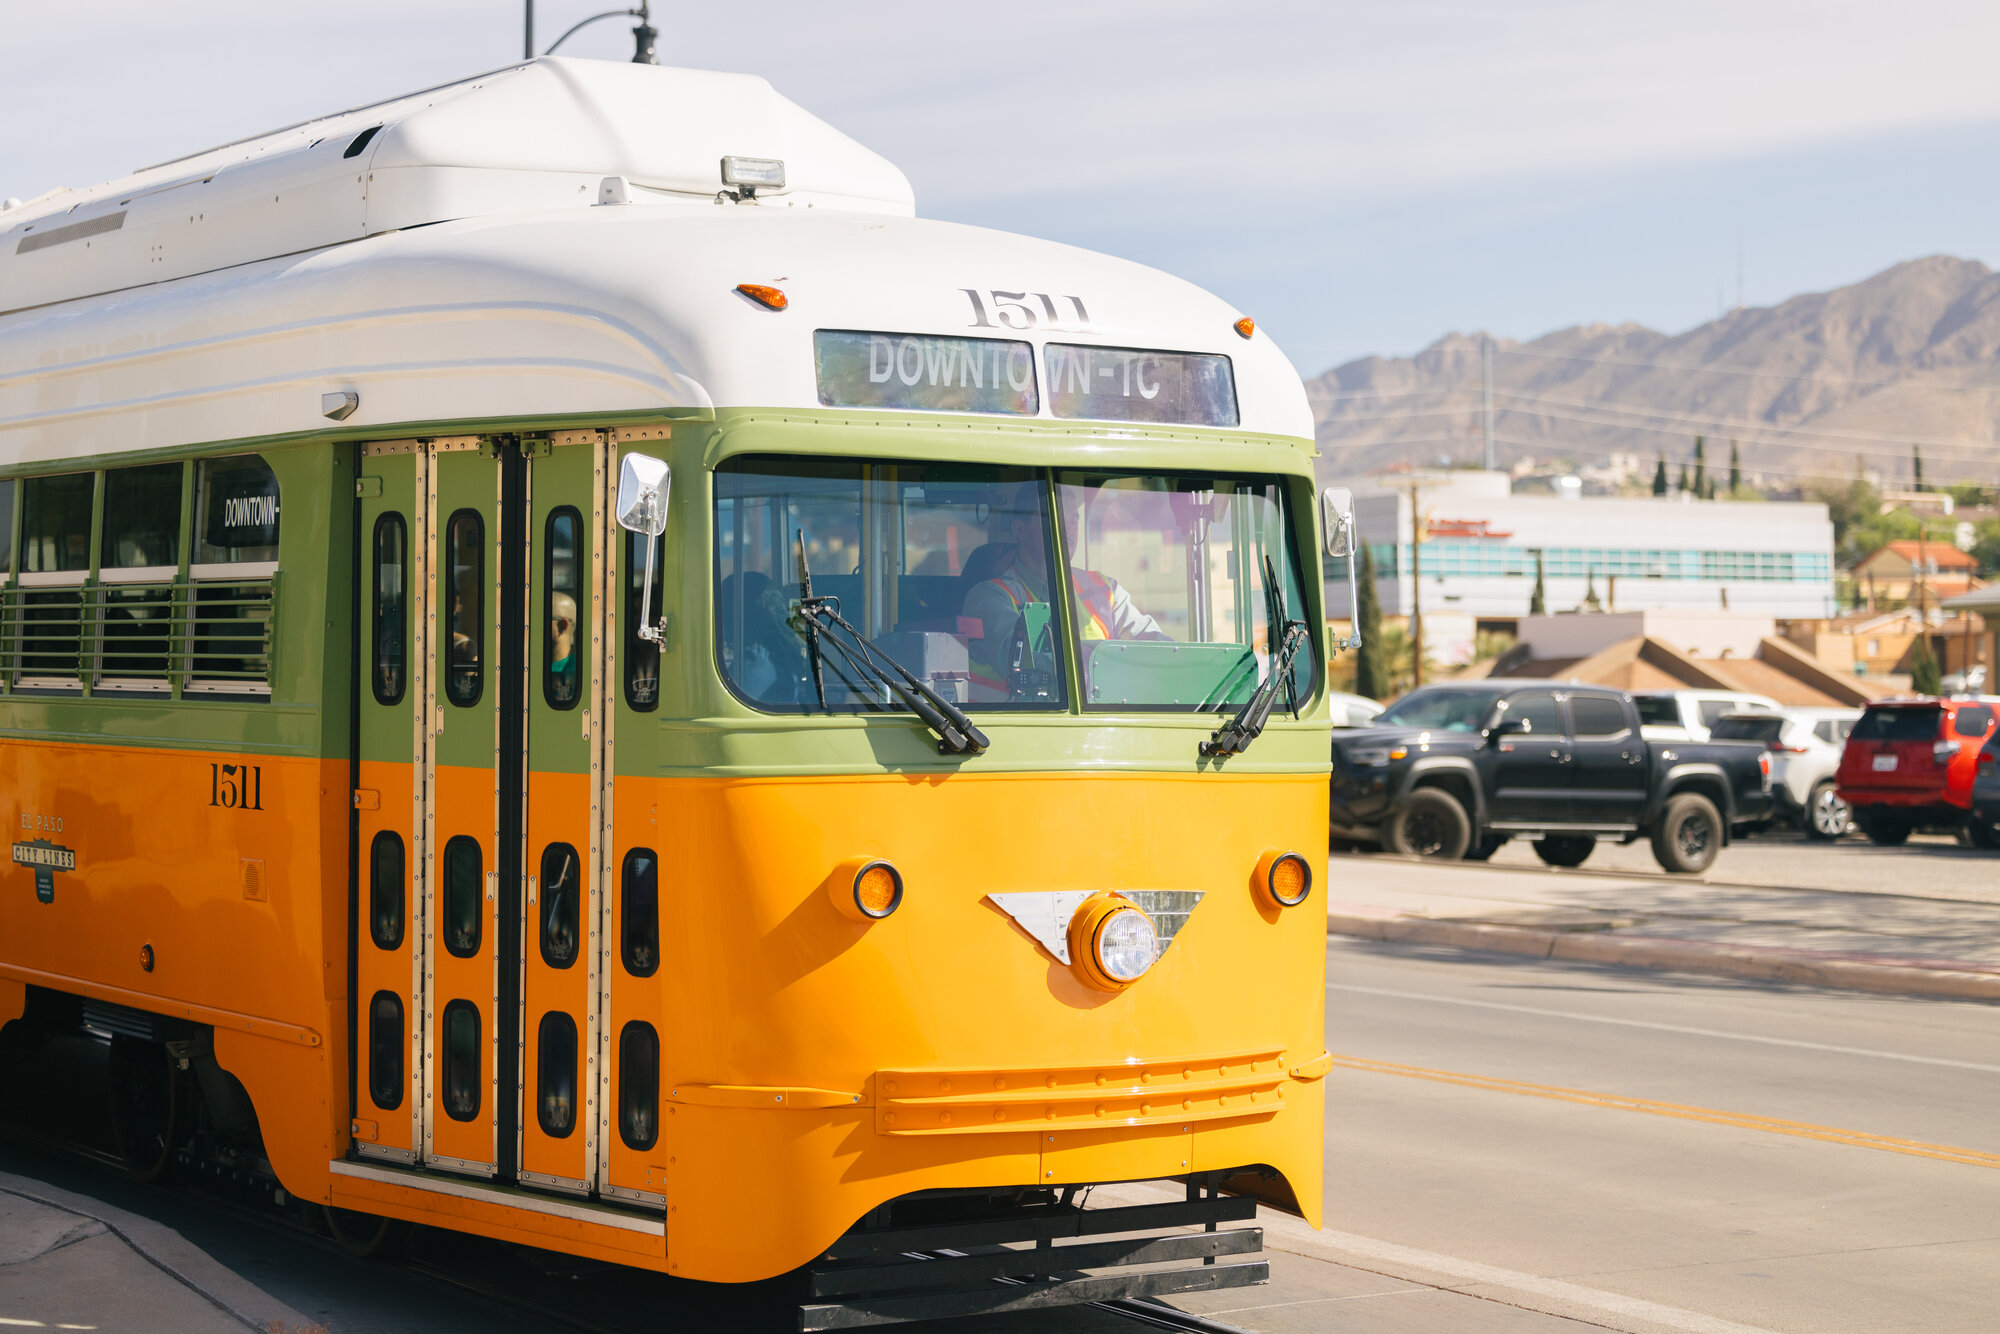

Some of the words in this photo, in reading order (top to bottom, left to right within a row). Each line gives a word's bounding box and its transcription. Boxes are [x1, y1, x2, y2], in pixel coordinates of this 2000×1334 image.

[956, 288, 1103, 336] 1511
[208, 763, 264, 811] 1511
[21, 812, 33, 830] EL
[37, 814, 64, 833] PASO
[15, 847, 38, 862] CITY
[43, 849, 72, 867] LINES
